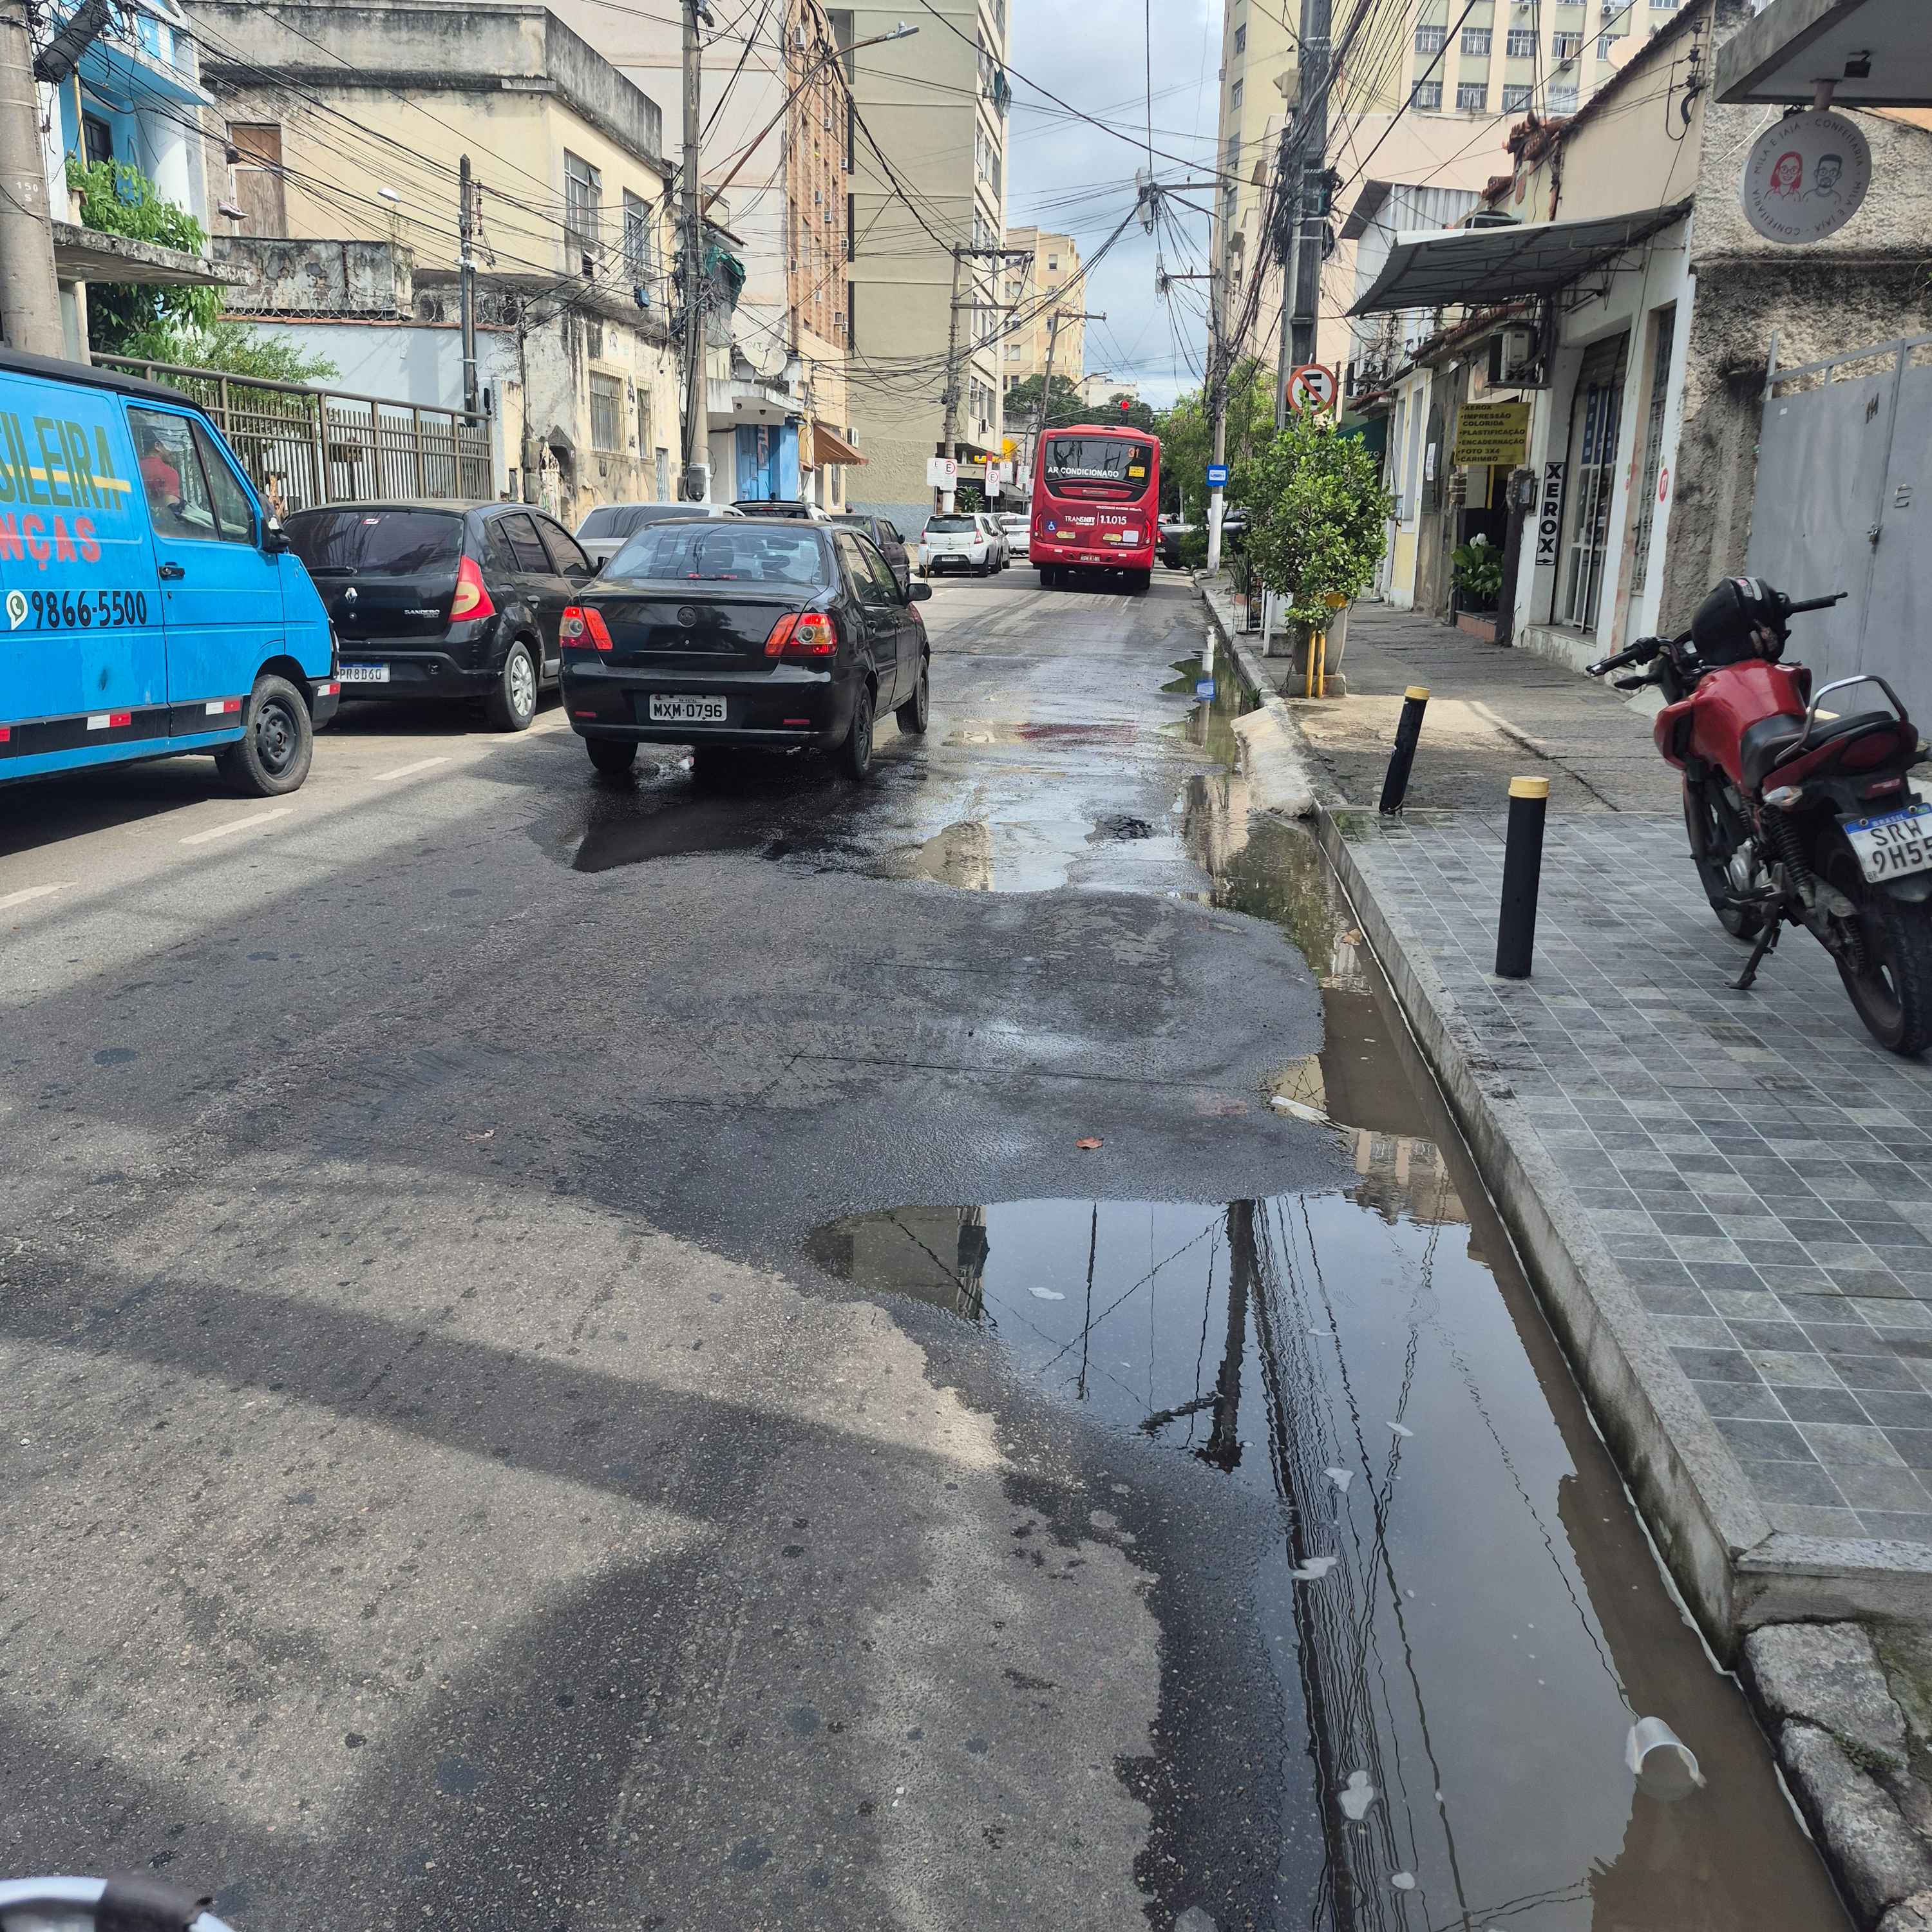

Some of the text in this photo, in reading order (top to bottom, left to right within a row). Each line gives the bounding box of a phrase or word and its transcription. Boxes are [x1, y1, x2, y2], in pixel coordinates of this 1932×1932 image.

[1815, 118, 1863, 167] CONFEITARIA
[1754, 149, 1770, 174] MILA
[15, 181, 39, 193] 150
[1846, 181, 1861, 206] MILA
[946, 463, 952, 473] E
[1060, 467, 1119, 478] CONDICIONADO
[1539, 464, 1562, 553] XEROX
[32, 591, 147, 629] 9866-5500
[1870, 819, 1923, 846] SRW
[1871, 813, 1906, 827] BRASIL
